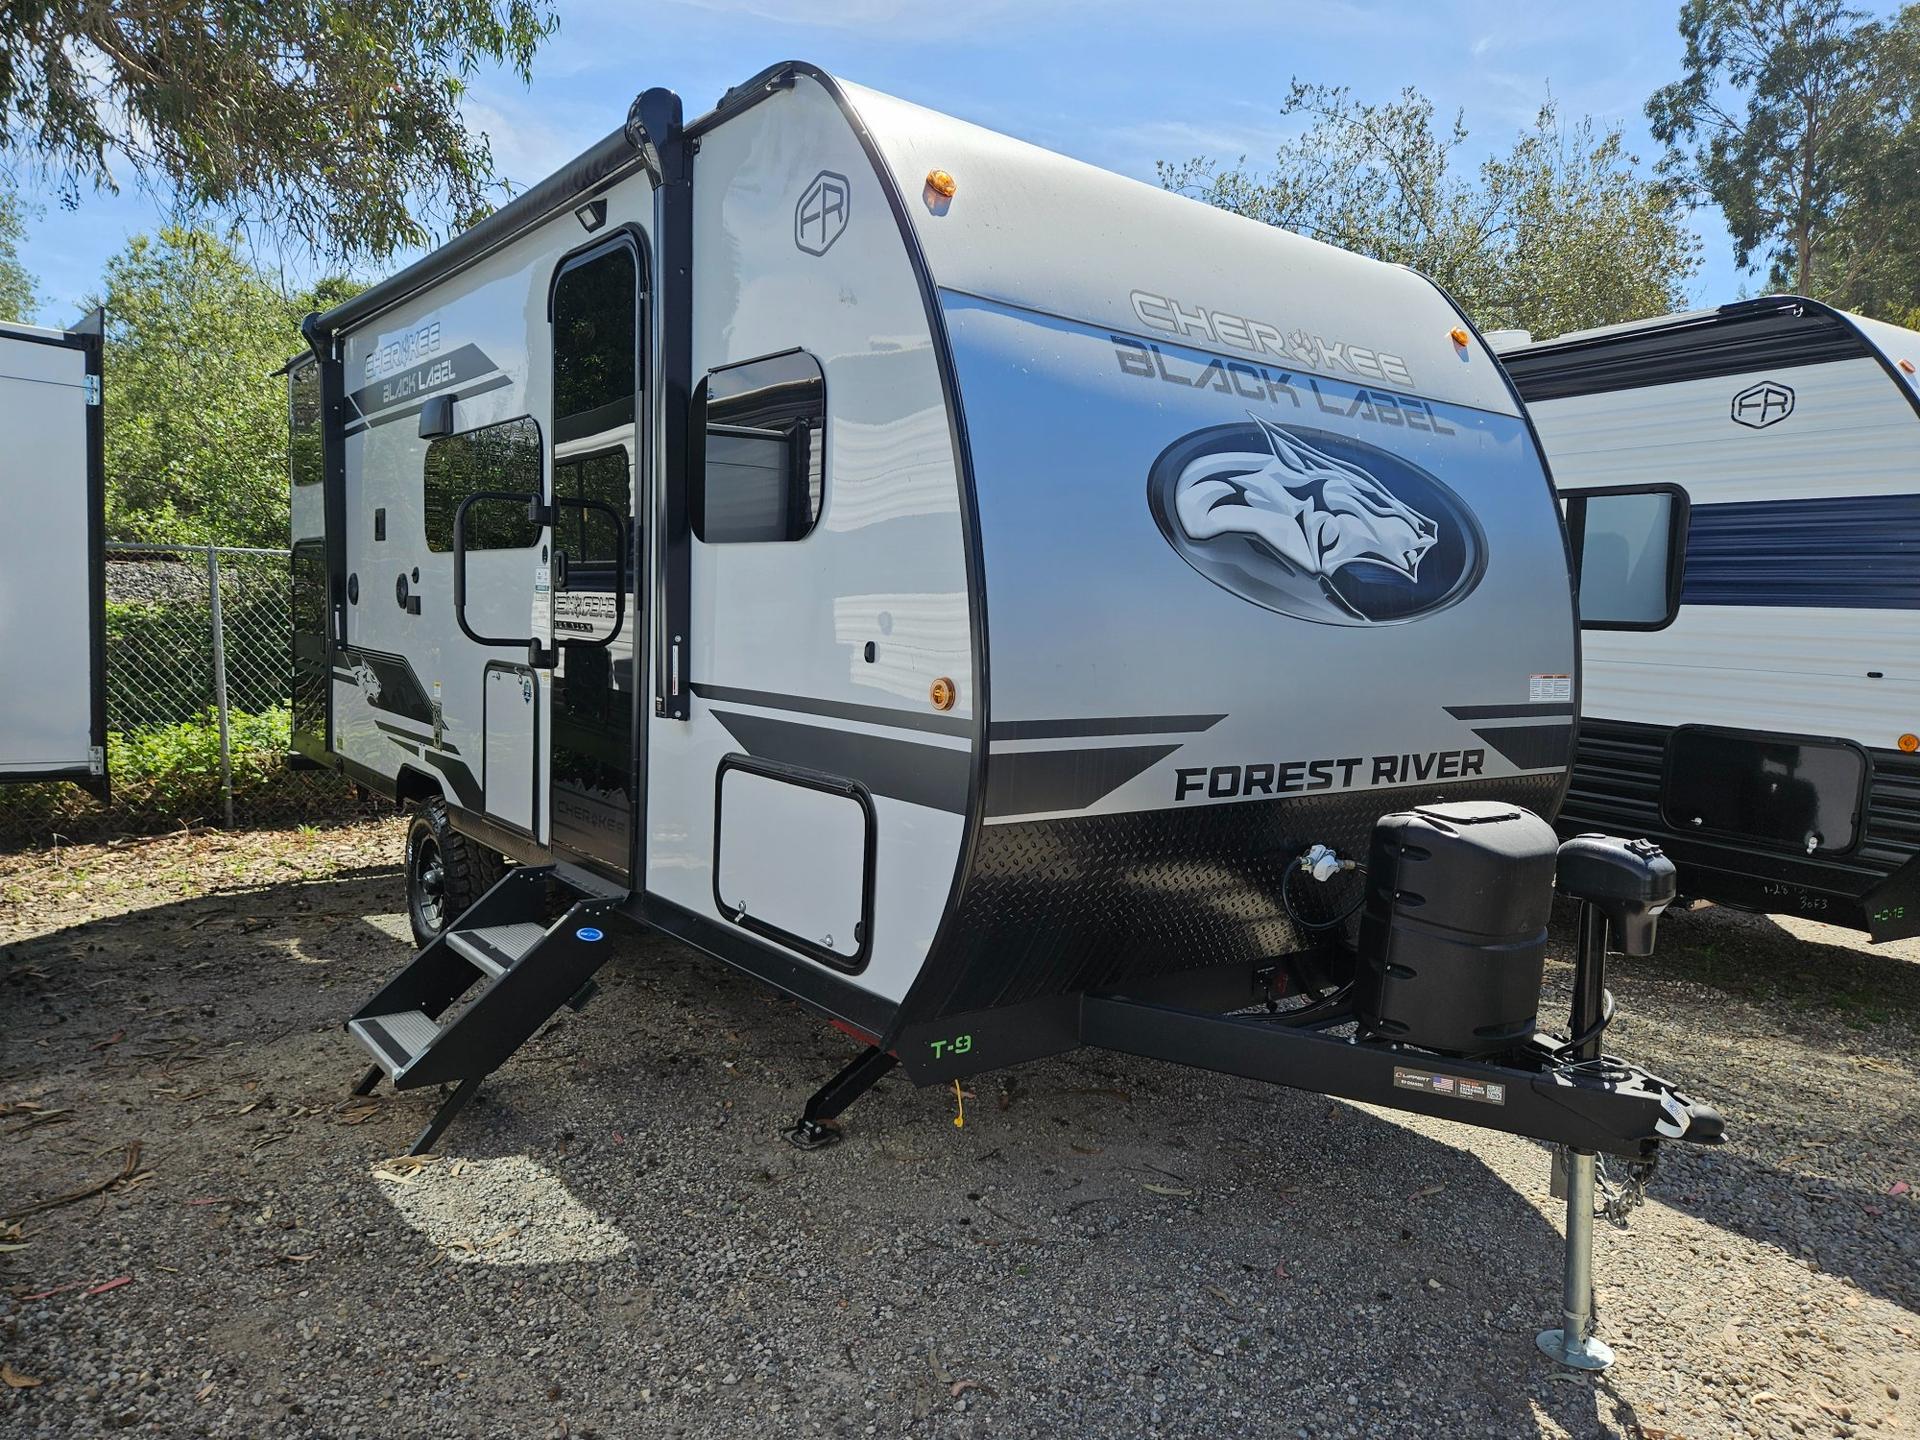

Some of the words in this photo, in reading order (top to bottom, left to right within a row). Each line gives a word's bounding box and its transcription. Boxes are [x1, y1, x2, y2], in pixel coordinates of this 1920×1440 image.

[383, 372, 417, 403] BLACK
[418, 359, 456, 390] LABEL
[1110, 335, 1301, 408] BLACK
[1310, 379, 1456, 436] LABEL
[1175, 758, 1363, 801] FOREST
[1371, 748, 1485, 785] RIVER
[930, 1035, 972, 1059] T-9
